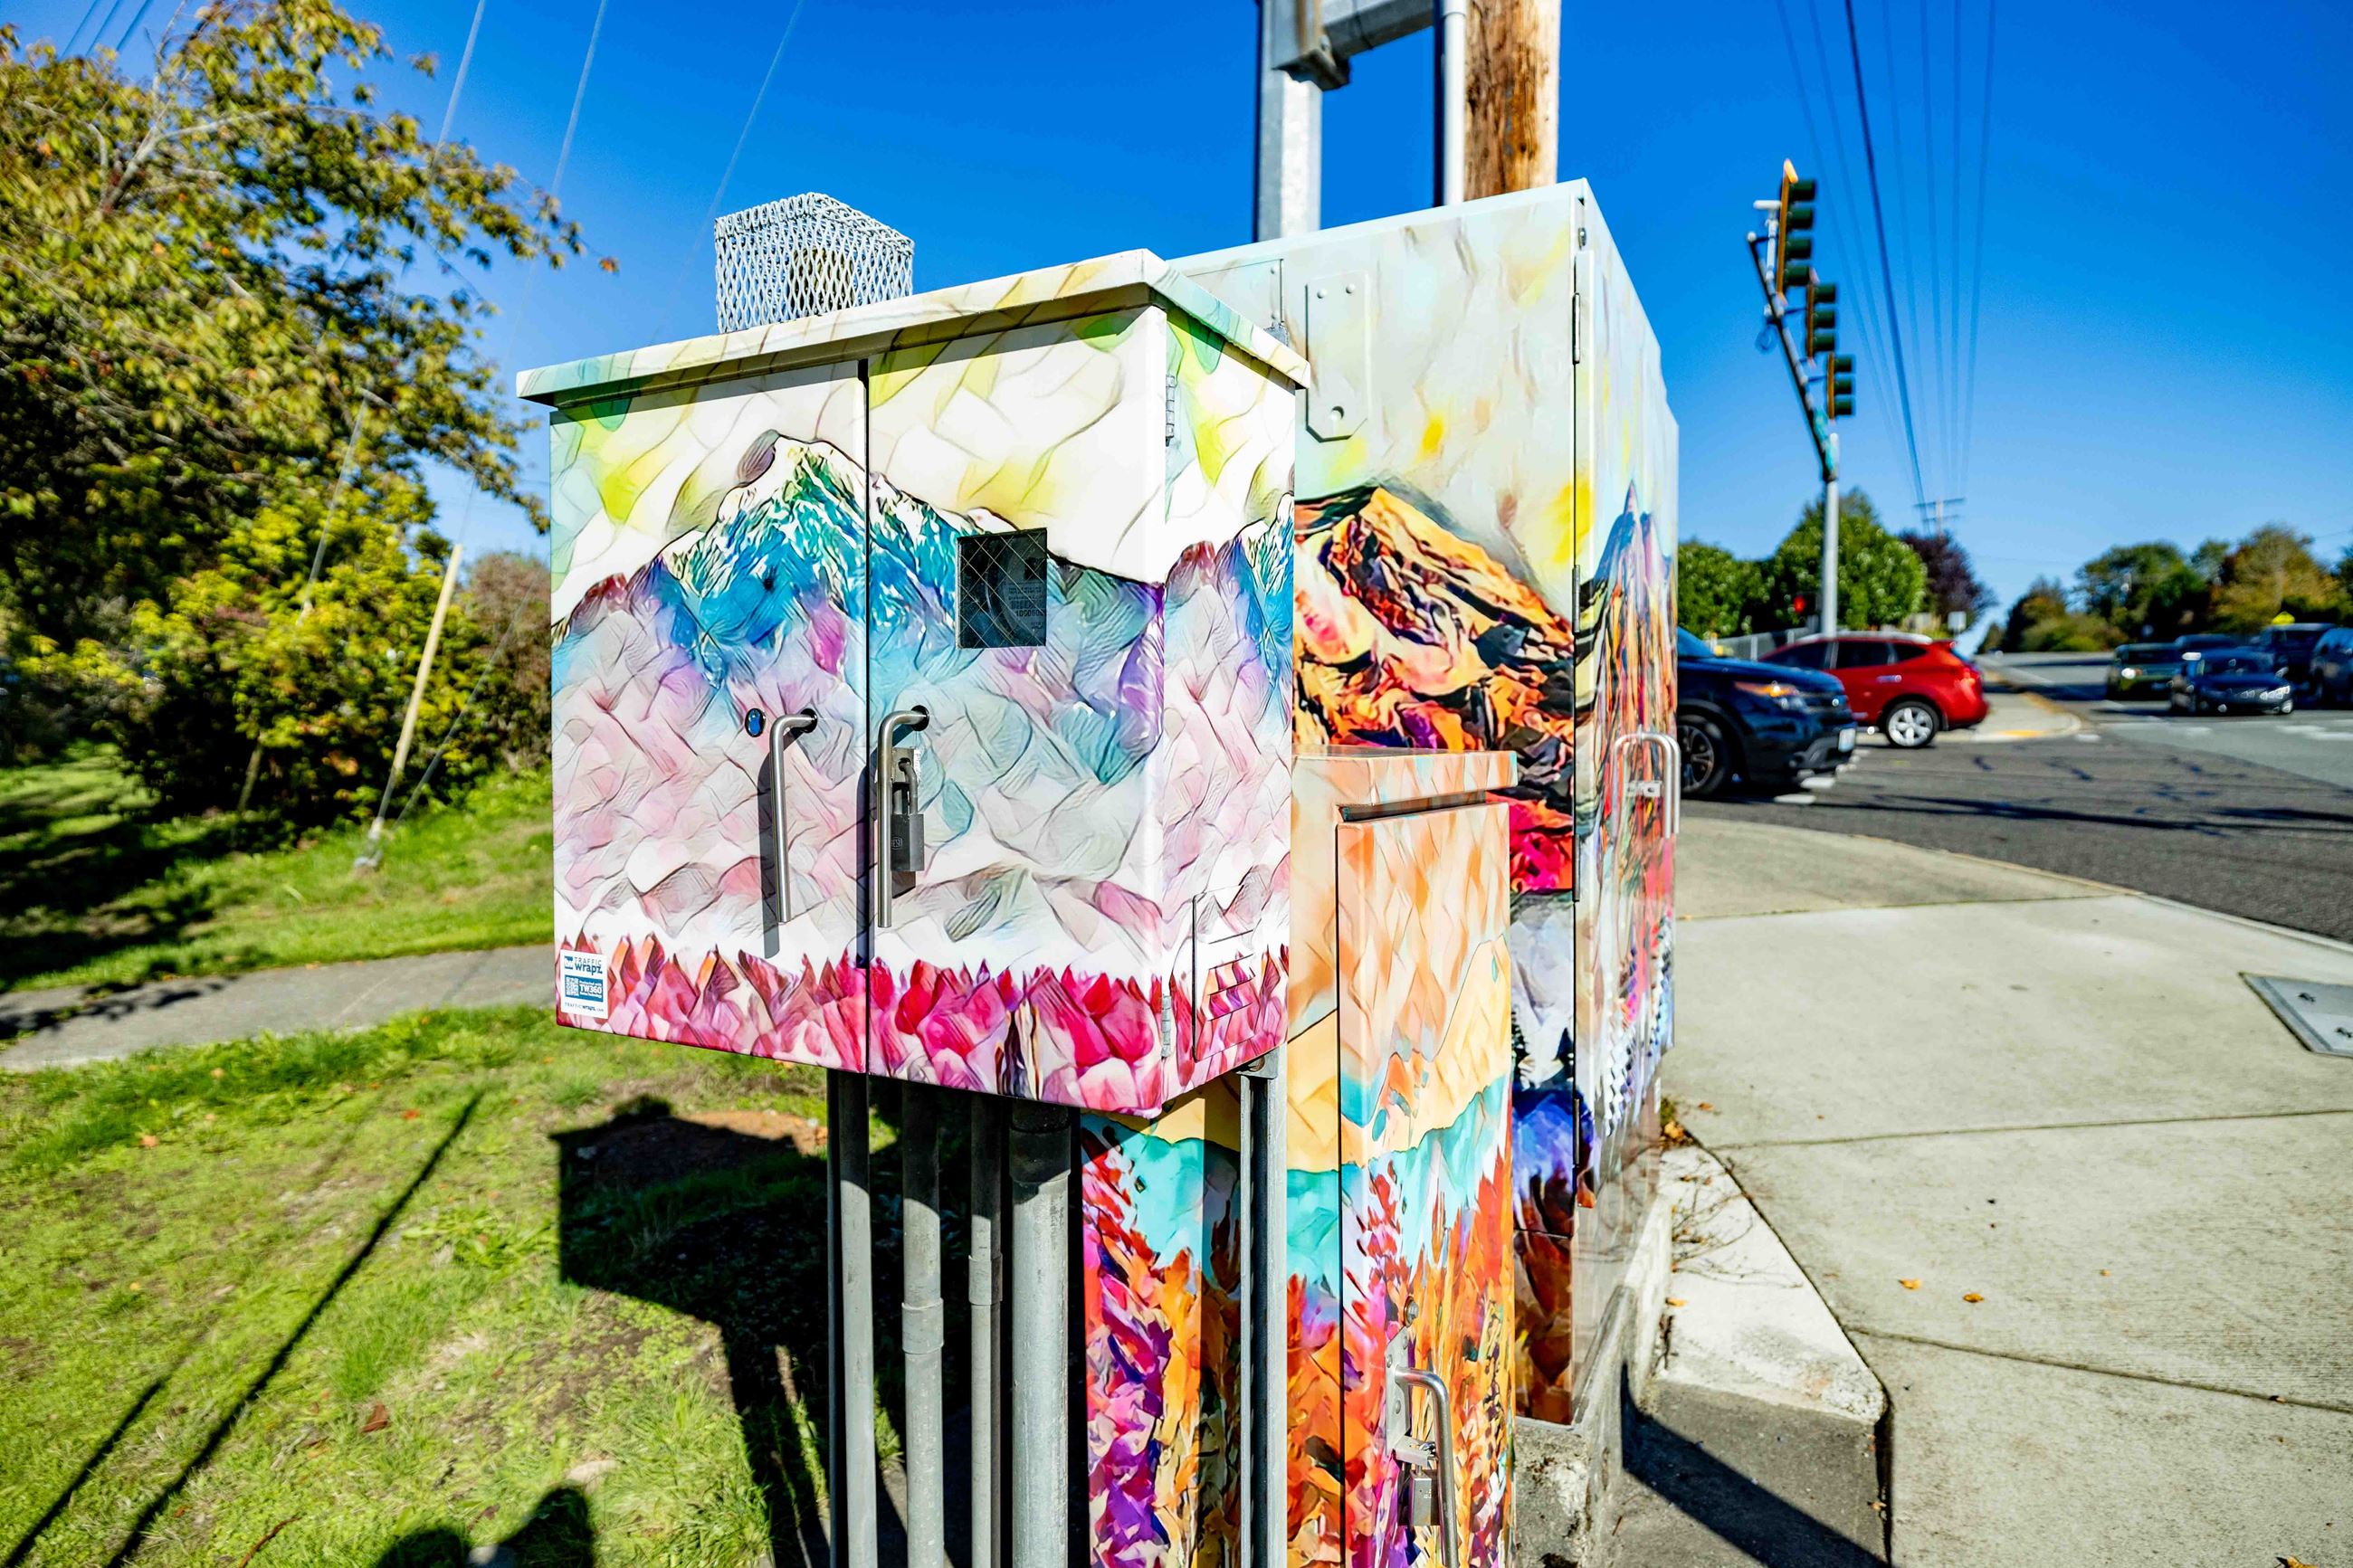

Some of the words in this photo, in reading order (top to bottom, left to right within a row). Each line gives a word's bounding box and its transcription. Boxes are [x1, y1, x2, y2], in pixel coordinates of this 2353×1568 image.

[575, 957, 602, 966] TRAFFIC
[575, 963, 603, 975] wrapz
[579, 984, 602, 994] TW360
